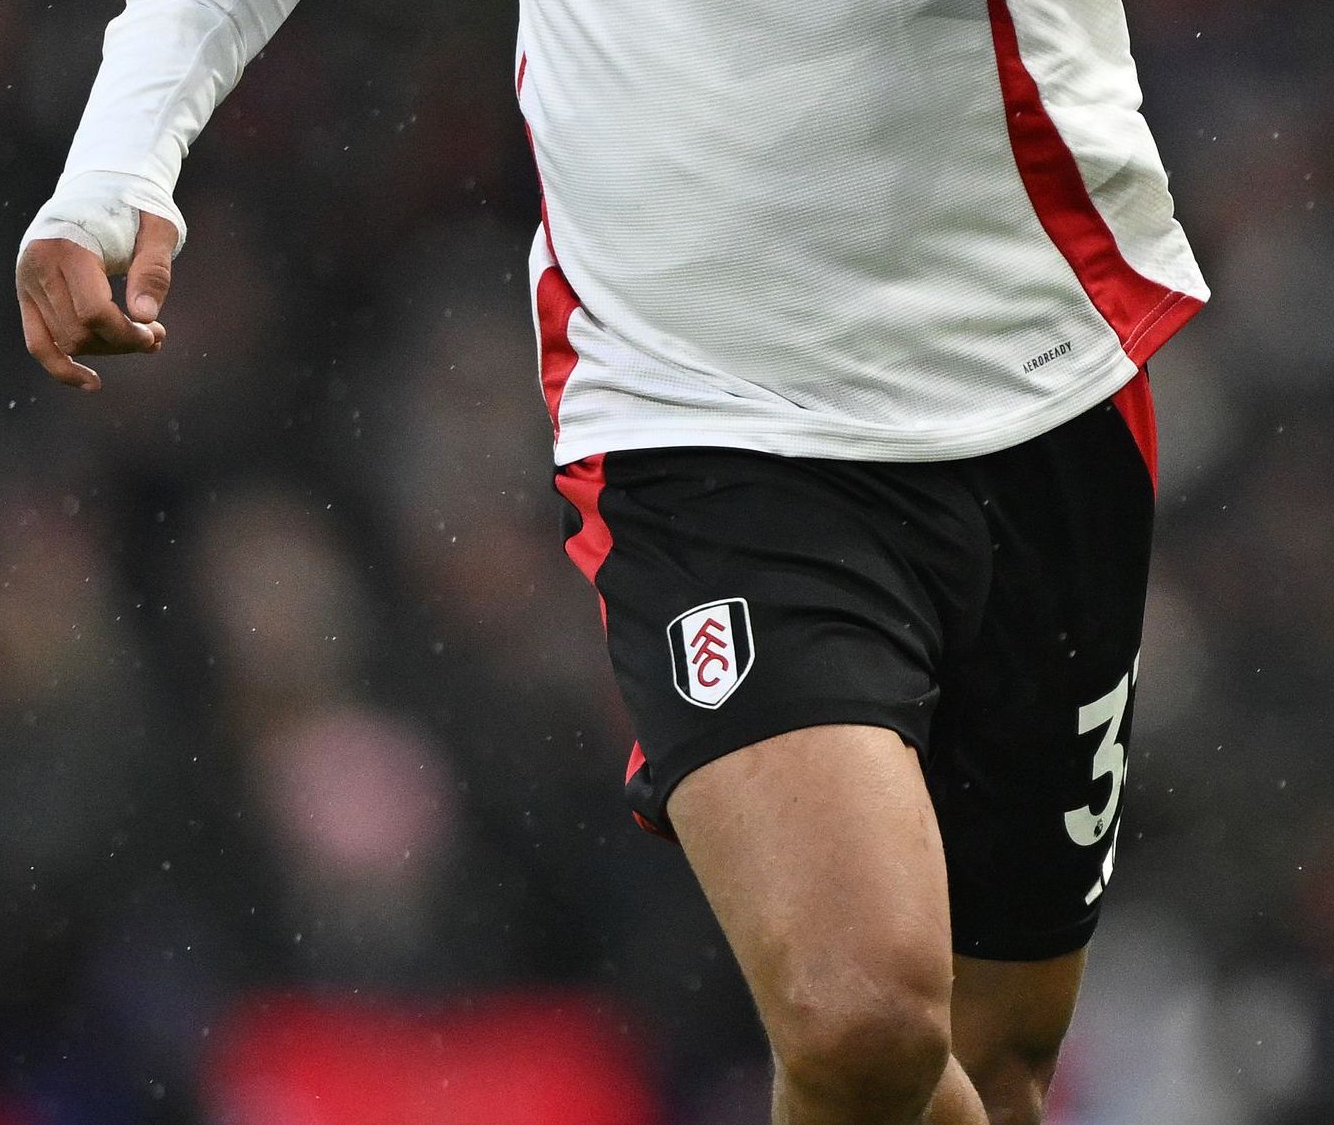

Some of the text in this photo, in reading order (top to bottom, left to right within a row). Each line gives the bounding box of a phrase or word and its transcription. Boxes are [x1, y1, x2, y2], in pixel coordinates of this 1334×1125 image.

[1022, 340, 1072, 375] AEROREADY
[690, 617, 729, 688] FFC
[1063, 648, 1142, 848] 3
